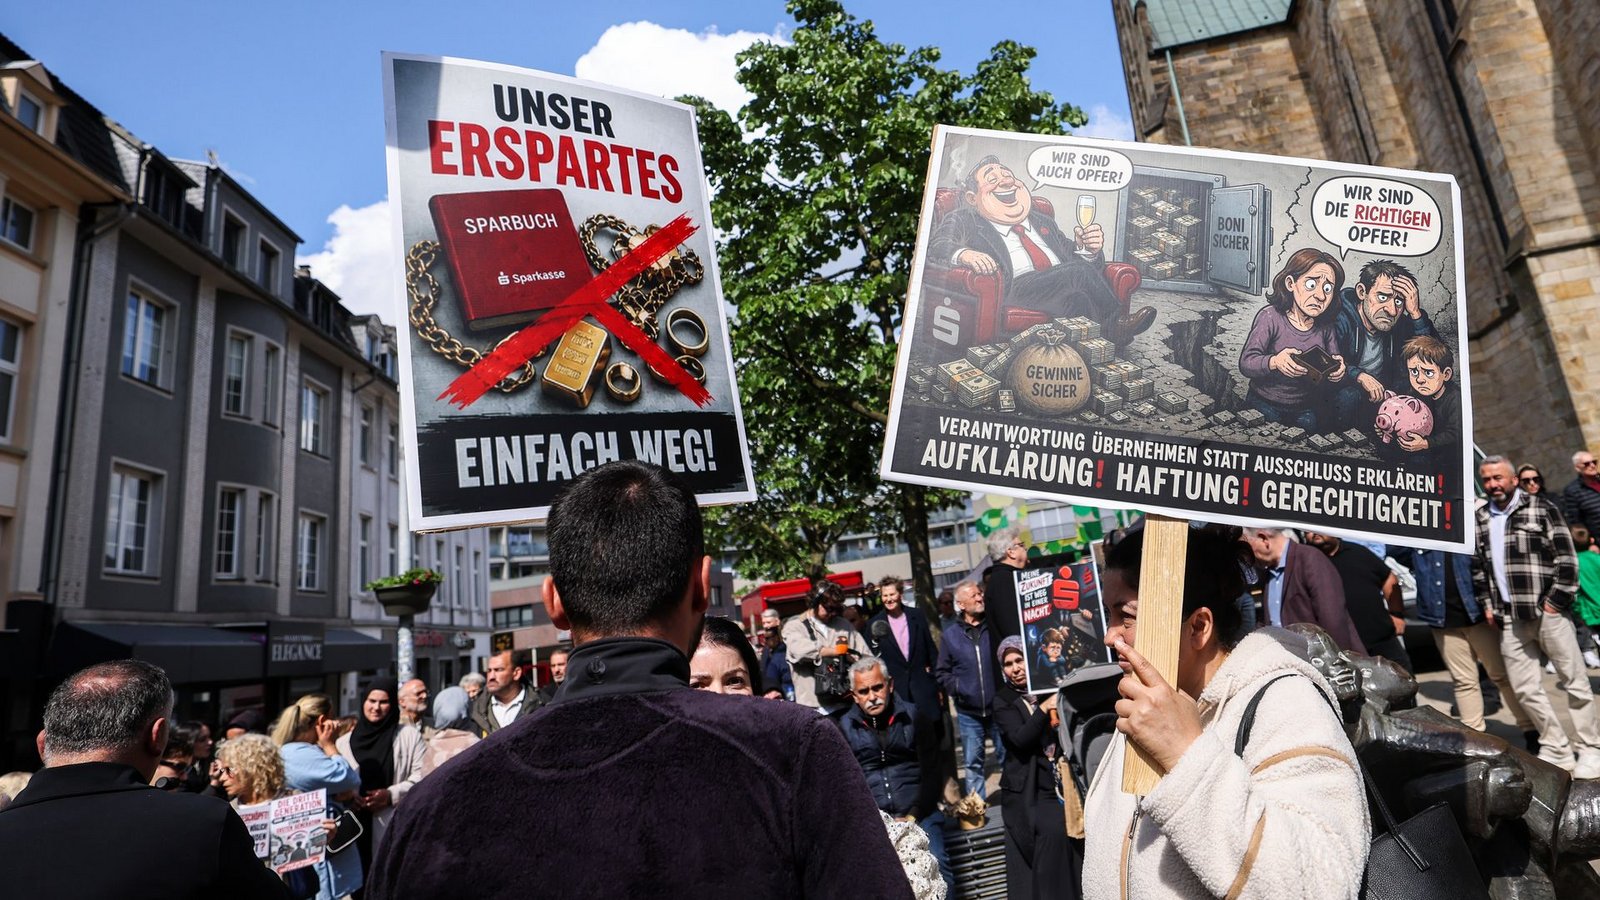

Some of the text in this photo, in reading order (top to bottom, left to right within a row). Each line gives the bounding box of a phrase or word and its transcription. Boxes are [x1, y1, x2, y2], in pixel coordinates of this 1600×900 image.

[493, 84, 615, 138] UNSER
[428, 119, 683, 203] ERSPARTES
[1051, 151, 1110, 168] WIR SIND
[1036, 164, 1123, 184] AUCH OPFER!
[1343, 184, 1413, 206] WIR SIND
[464, 213, 558, 234] SPARBUCH
[1324, 201, 1431, 228] DIE RICHTIGEN
[1217, 216, 1245, 233] BONI
[1212, 233, 1250, 251] SICHER
[1348, 225, 1409, 248] OPFER!
[512, 270, 566, 285] Sparkasse
[1026, 364, 1083, 381] GEWINNE
[1031, 382, 1077, 398] SICHER
[455, 428, 717, 488] EINFACH WEG!
[939, 416, 1444, 495] VERANTWORTUNG ÜBERNEHMEN STATT AUSSCHLUSS ERKLÄREN!
[920, 438, 1452, 530] AUFKLÄRUNG! HAFTUNG! GERECHTIGKEIT!
[1020, 574, 1051, 592] ZUKUNFT
[1021, 569, 1040, 580] MEINE
[1024, 588, 1047, 602] IST WEG
[1031, 597, 1048, 607] EINER
[272, 643, 322, 661] ELEGANCE
[274, 800, 321, 817] GENERATION
[278, 792, 320, 809] DIE DRITTE
